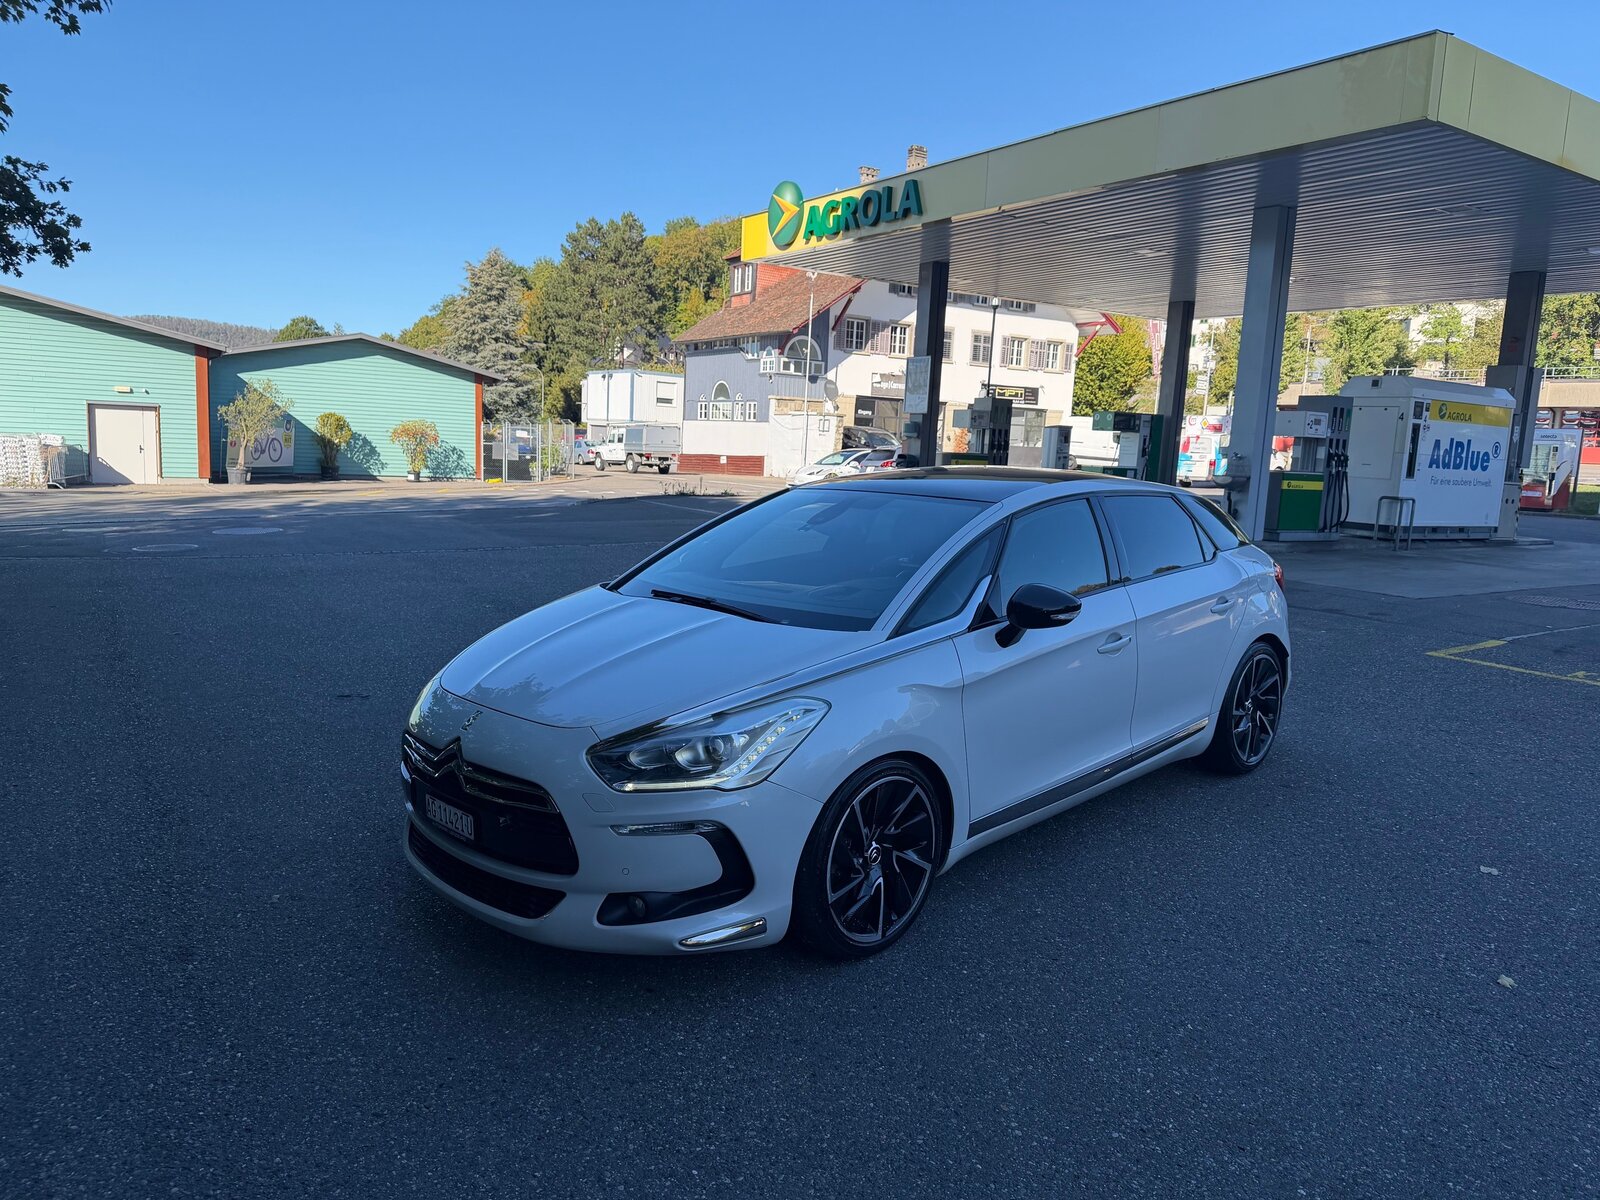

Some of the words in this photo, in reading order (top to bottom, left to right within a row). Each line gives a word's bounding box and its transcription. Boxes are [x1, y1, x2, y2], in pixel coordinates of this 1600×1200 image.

[803, 179, 923, 241] AGROLA
[996, 389, 1024, 398] MPT
[1398, 412, 1404, 421] 4
[1446, 412, 1472, 422] AGROLA
[1440, 477, 1451, 486] eine
[1452, 477, 1472, 487] saubere
